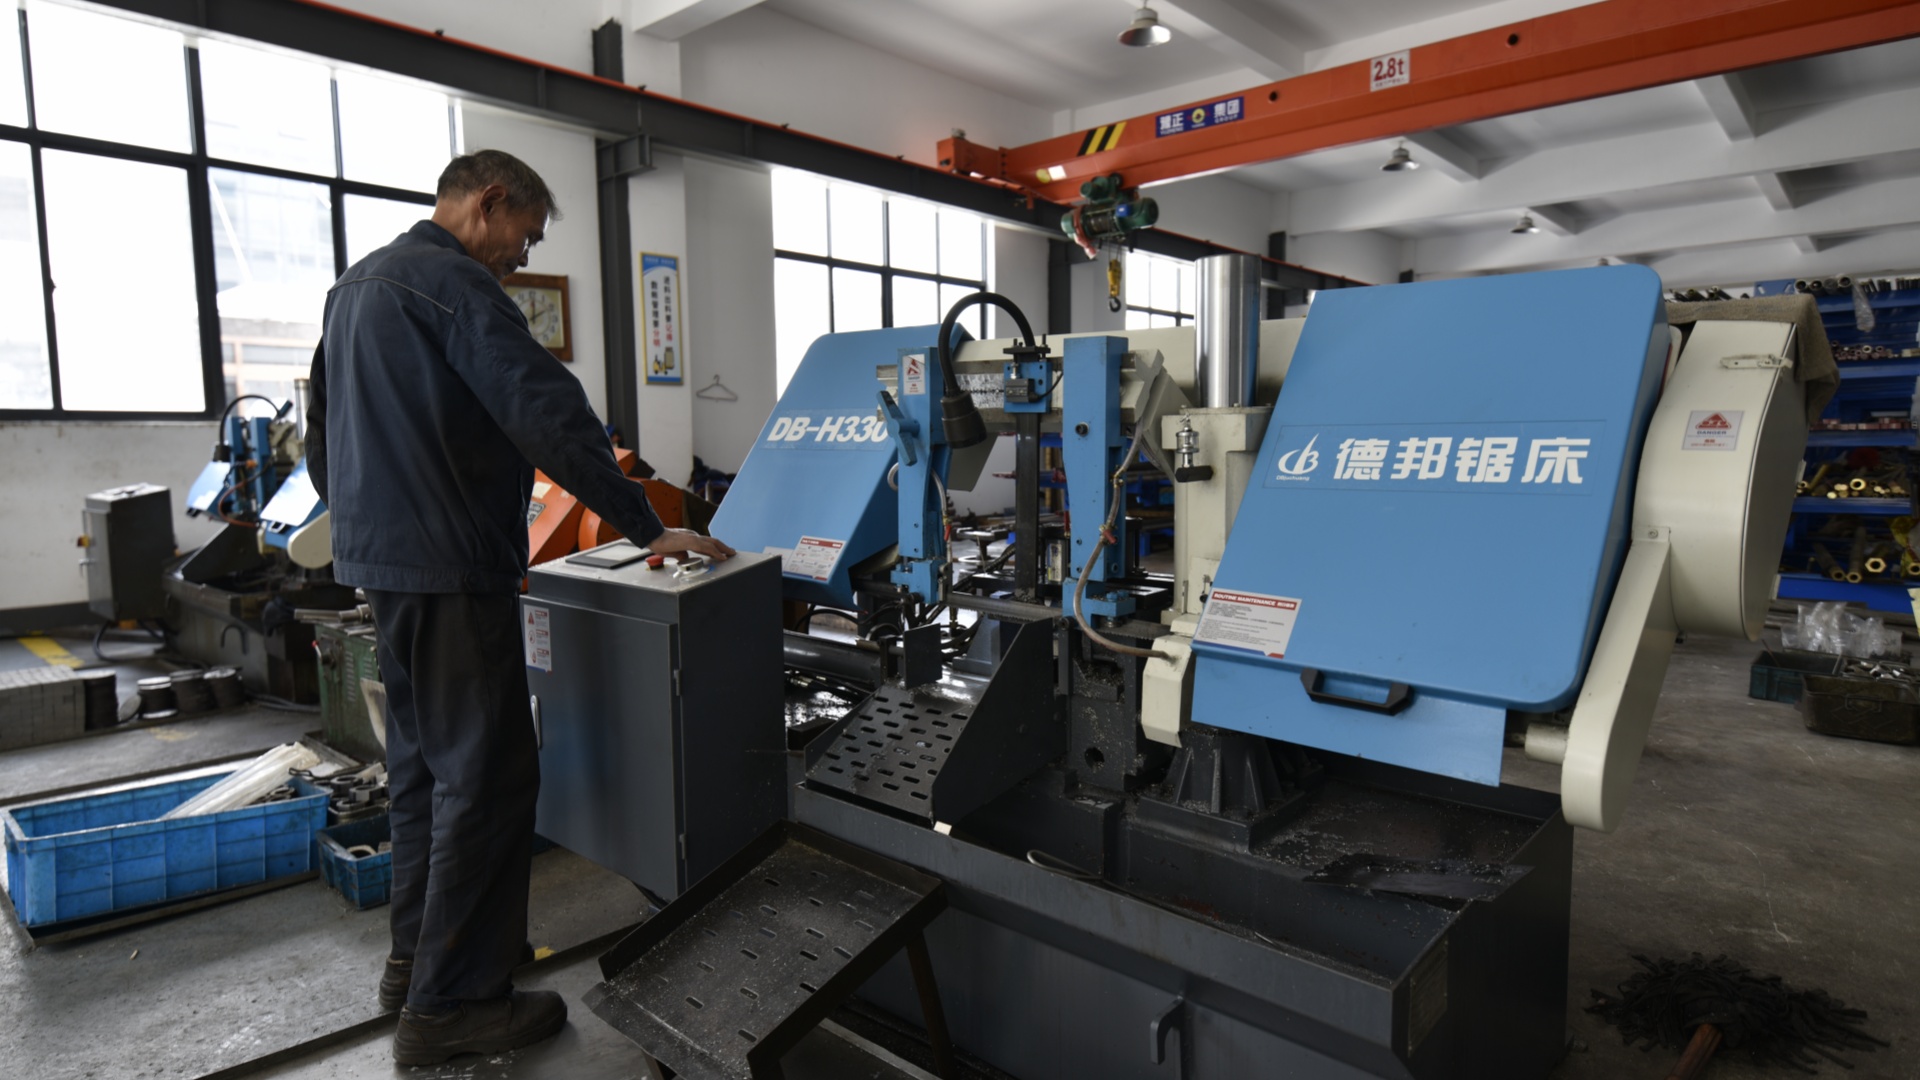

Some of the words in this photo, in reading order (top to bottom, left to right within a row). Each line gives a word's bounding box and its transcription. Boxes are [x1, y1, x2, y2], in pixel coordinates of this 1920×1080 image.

[1374, 57, 1404, 82] 2.8t
[1214, 98, 1240, 118] 集团
[1215, 114, 1238, 123] GROUP
[767, 416, 888, 442] DB-H330
[1333, 436, 1591, 485] 德邦锯床
[1213, 593, 1237, 601] ROUTINE
[1237, 595, 1276, 607] MAINTENANCE
